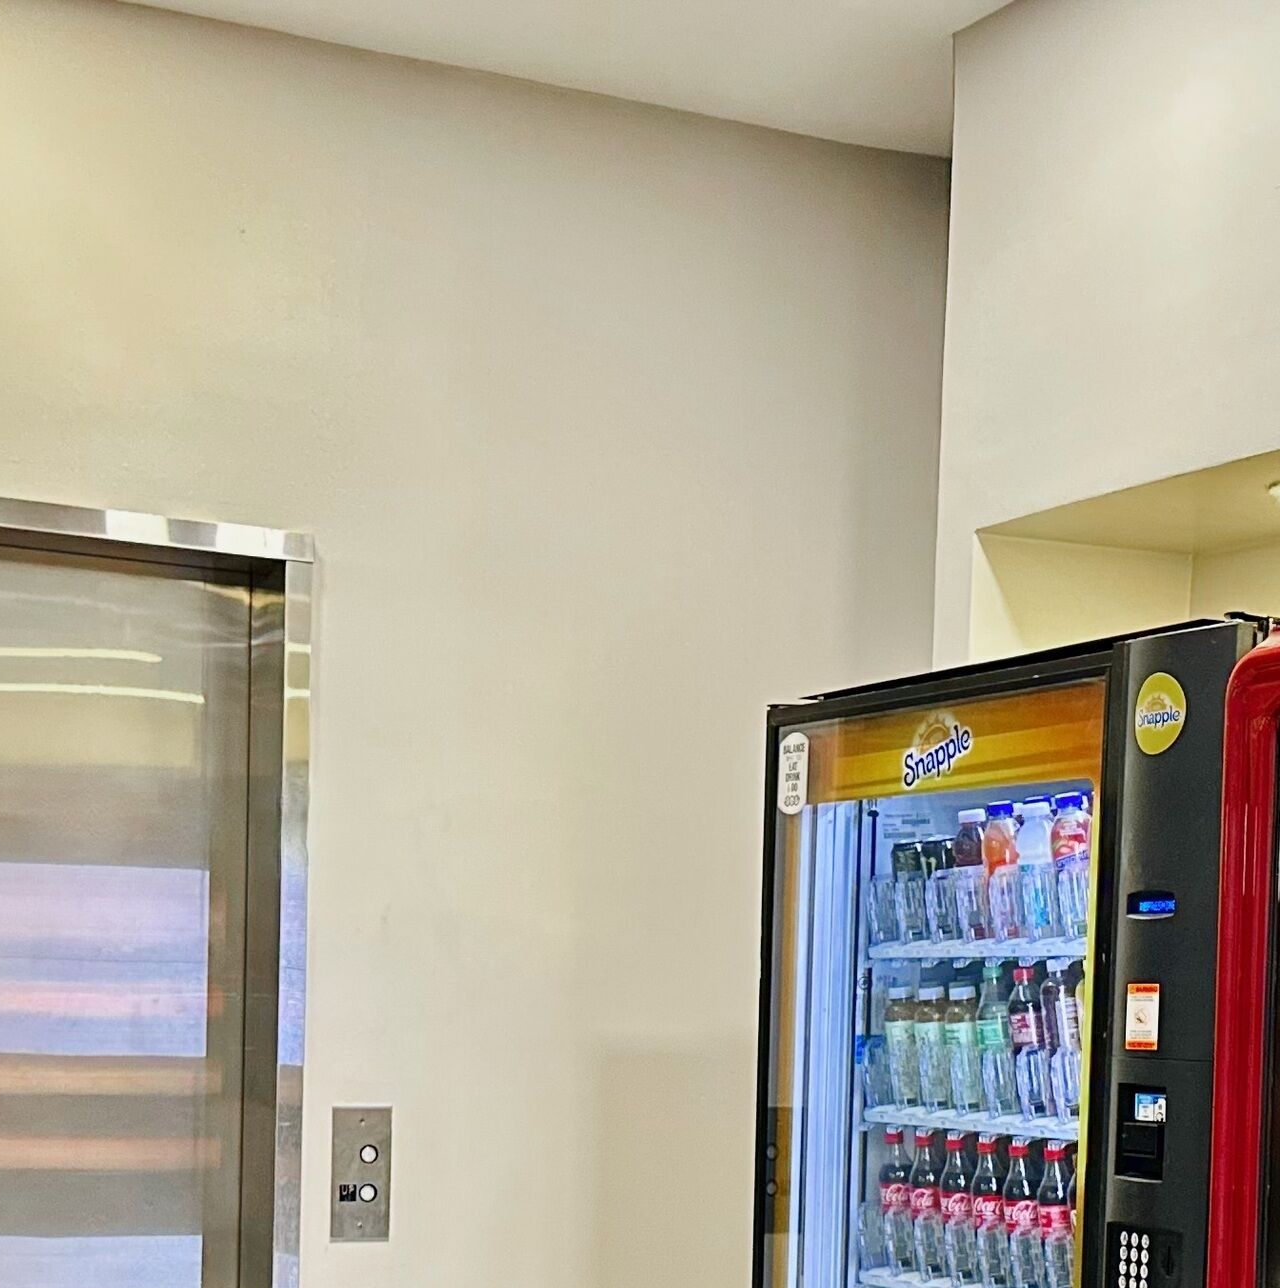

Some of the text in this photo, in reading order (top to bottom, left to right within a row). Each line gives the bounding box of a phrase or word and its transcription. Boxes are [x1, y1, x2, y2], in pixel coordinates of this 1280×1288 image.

[1137, 704, 1181, 728] Snapple
[904, 724, 971, 788] Snapple
[341, 1184, 355, 1195] UP
